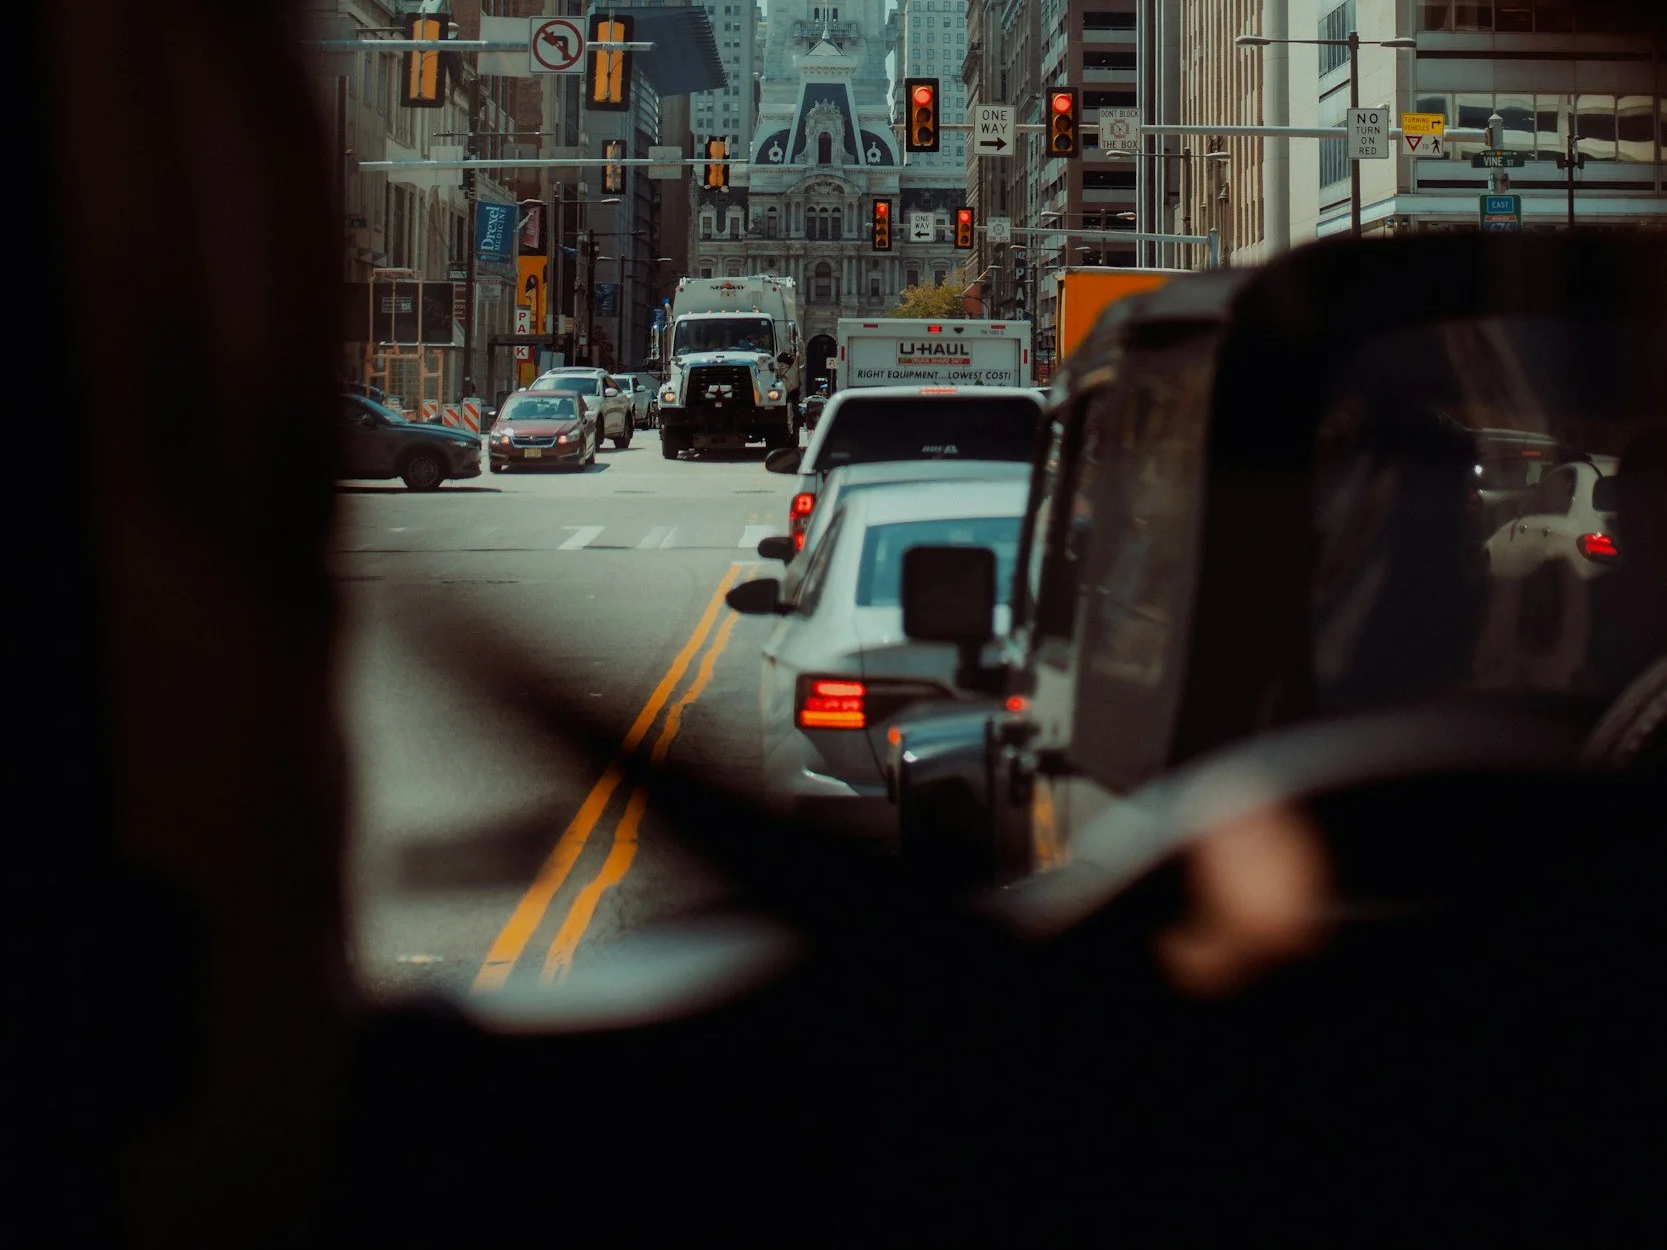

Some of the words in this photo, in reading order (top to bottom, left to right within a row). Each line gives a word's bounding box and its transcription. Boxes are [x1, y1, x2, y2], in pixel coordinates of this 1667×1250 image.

[982, 110, 1008, 121] ONE
[1357, 113, 1379, 124] NO
[1404, 116, 1430, 124] TURNING
[980, 123, 1008, 135] WAY
[1355, 126, 1380, 135] TURN
[1404, 124, 1430, 132] VEHICLES
[1102, 140, 1117, 148] THE
[1121, 140, 1138, 149] BOX
[1360, 136, 1375, 145] ON
[1359, 147, 1377, 155] RED
[1483, 156, 1503, 167] VINE
[1506, 159, 1514, 167] ST
[1491, 201, 1508, 209] EAST
[481, 206, 500, 251] Drexel
[494, 207, 507, 251] MEDICINE
[900, 343, 969, 355] U-HAUL
[857, 370, 884, 379] RIGHT
